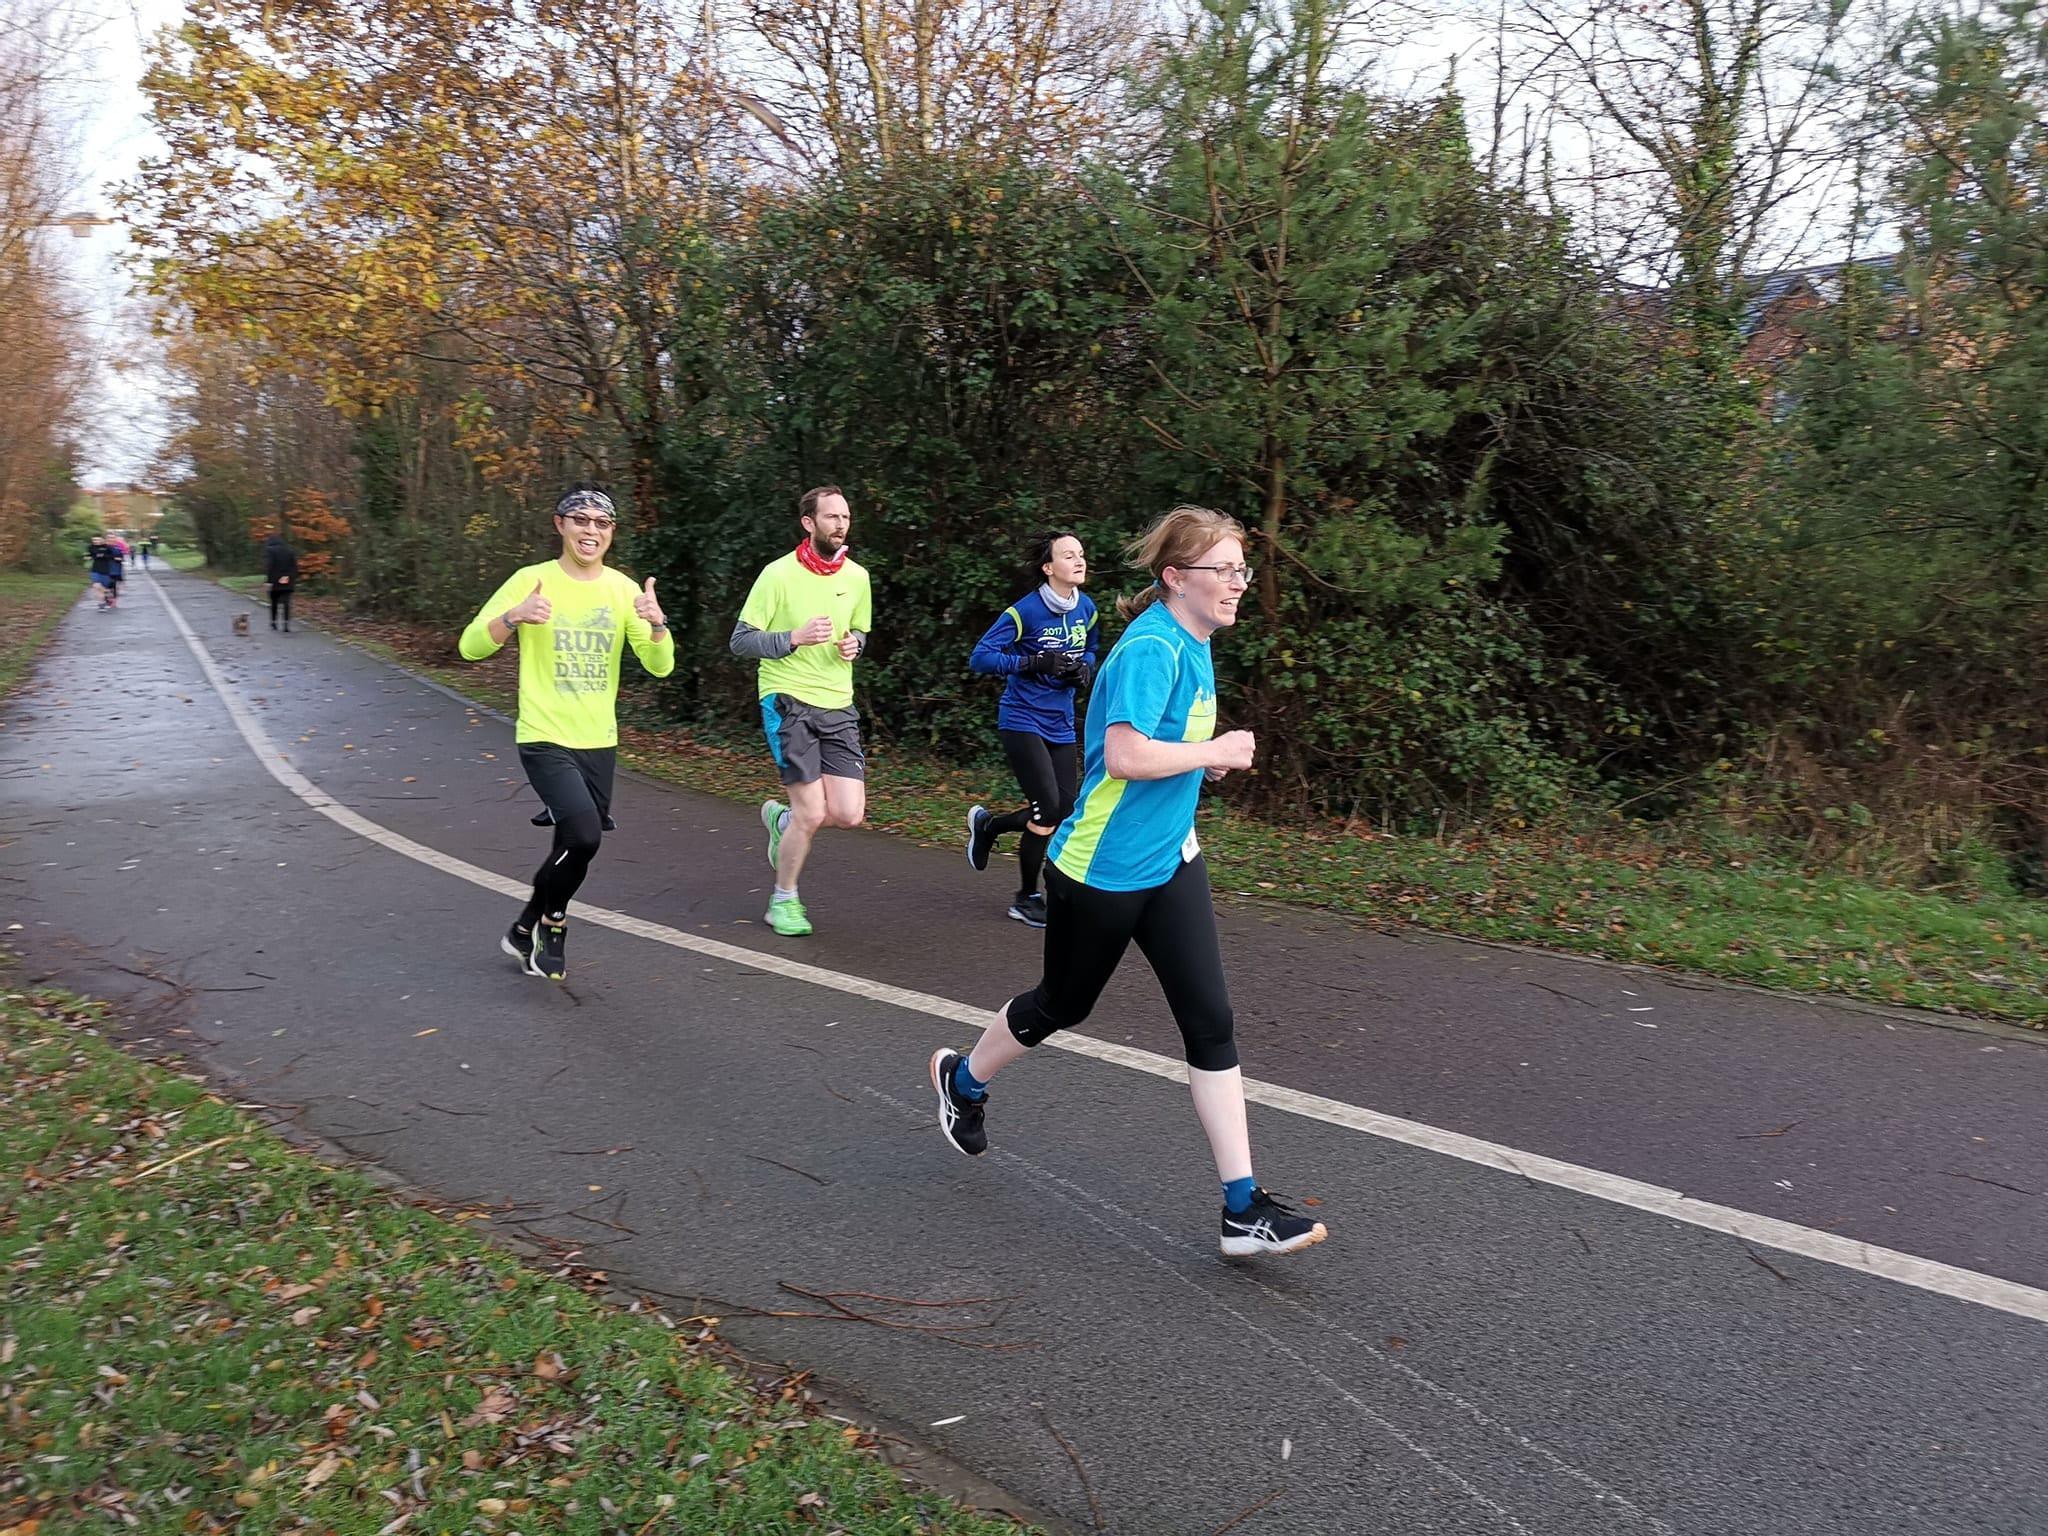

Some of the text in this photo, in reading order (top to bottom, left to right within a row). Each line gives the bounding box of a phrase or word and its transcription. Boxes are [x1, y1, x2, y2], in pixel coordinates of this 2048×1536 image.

[1042, 627, 1063, 636] 2017
[553, 629, 615, 653] RUN
[566, 653, 604, 662] IN THE
[554, 662, 608, 678] DARK
[583, 680, 608, 691] 2018
